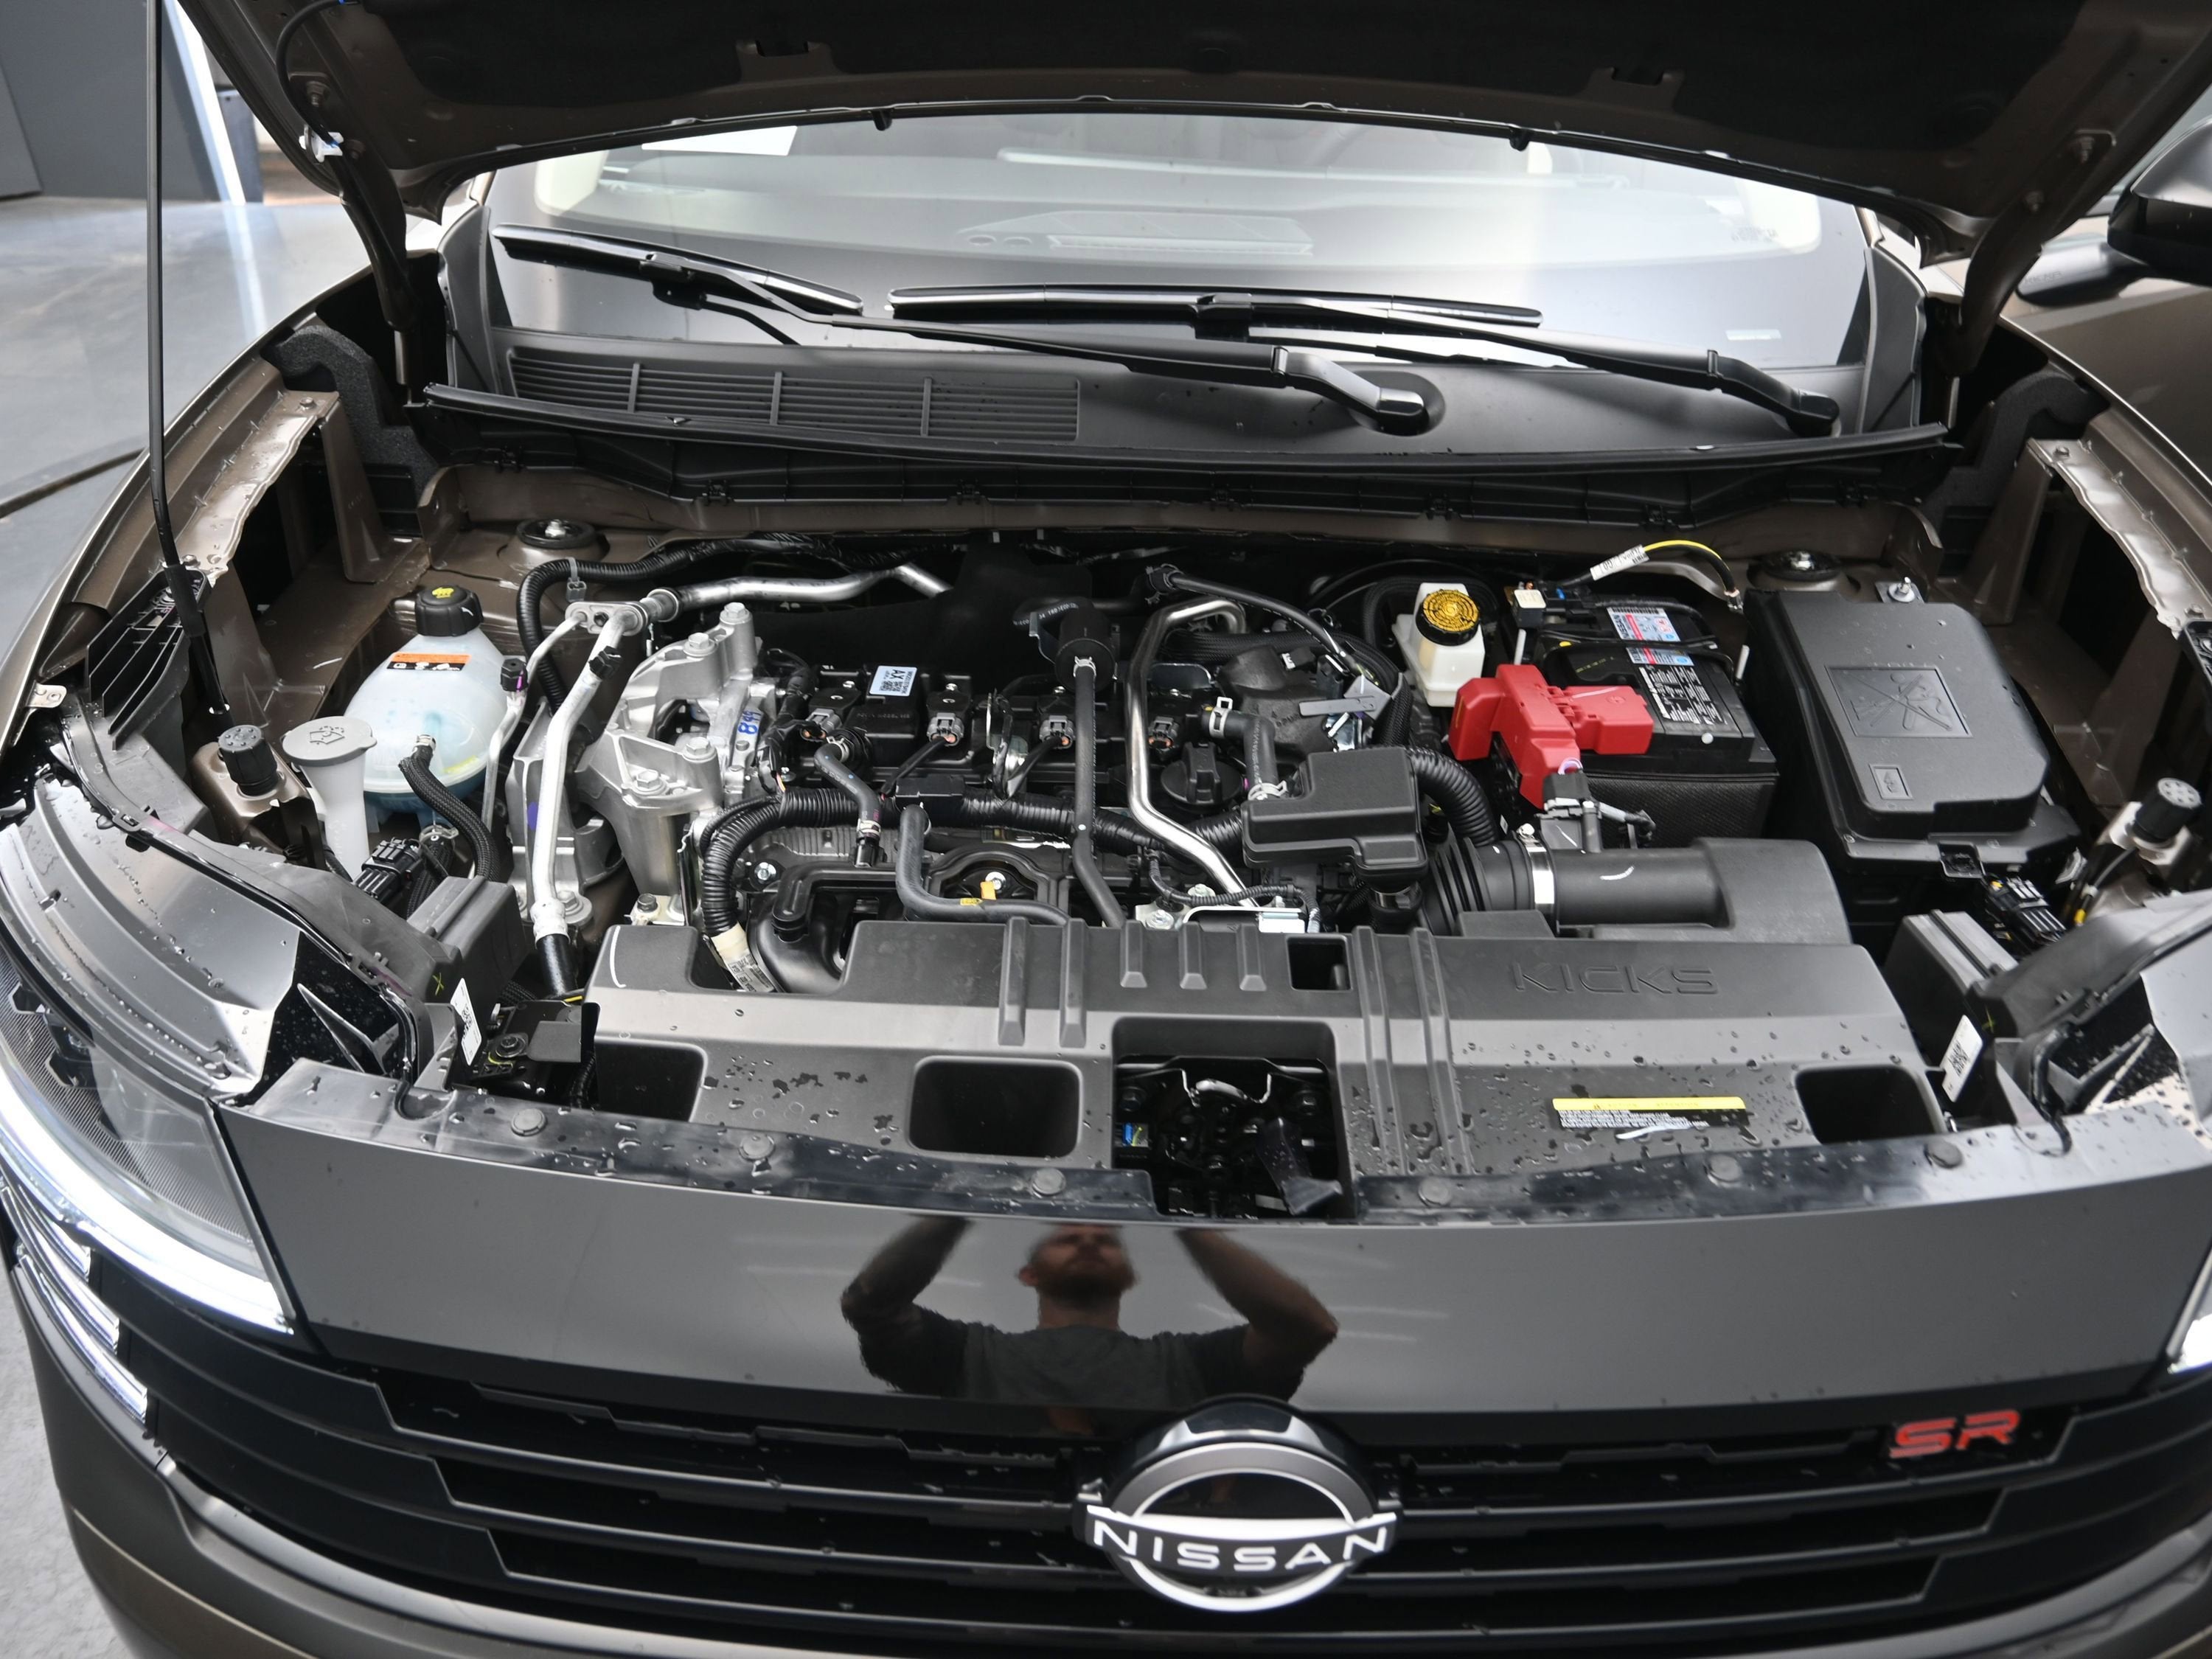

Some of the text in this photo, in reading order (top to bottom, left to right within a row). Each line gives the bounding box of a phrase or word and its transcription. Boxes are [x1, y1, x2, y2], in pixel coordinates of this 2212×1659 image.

[889, 669, 905, 680] AX
[1512, 961, 1719, 994] KICKS
[1889, 1409, 2021, 1458] SR
[1093, 1520, 1387, 1572] NISSAN
